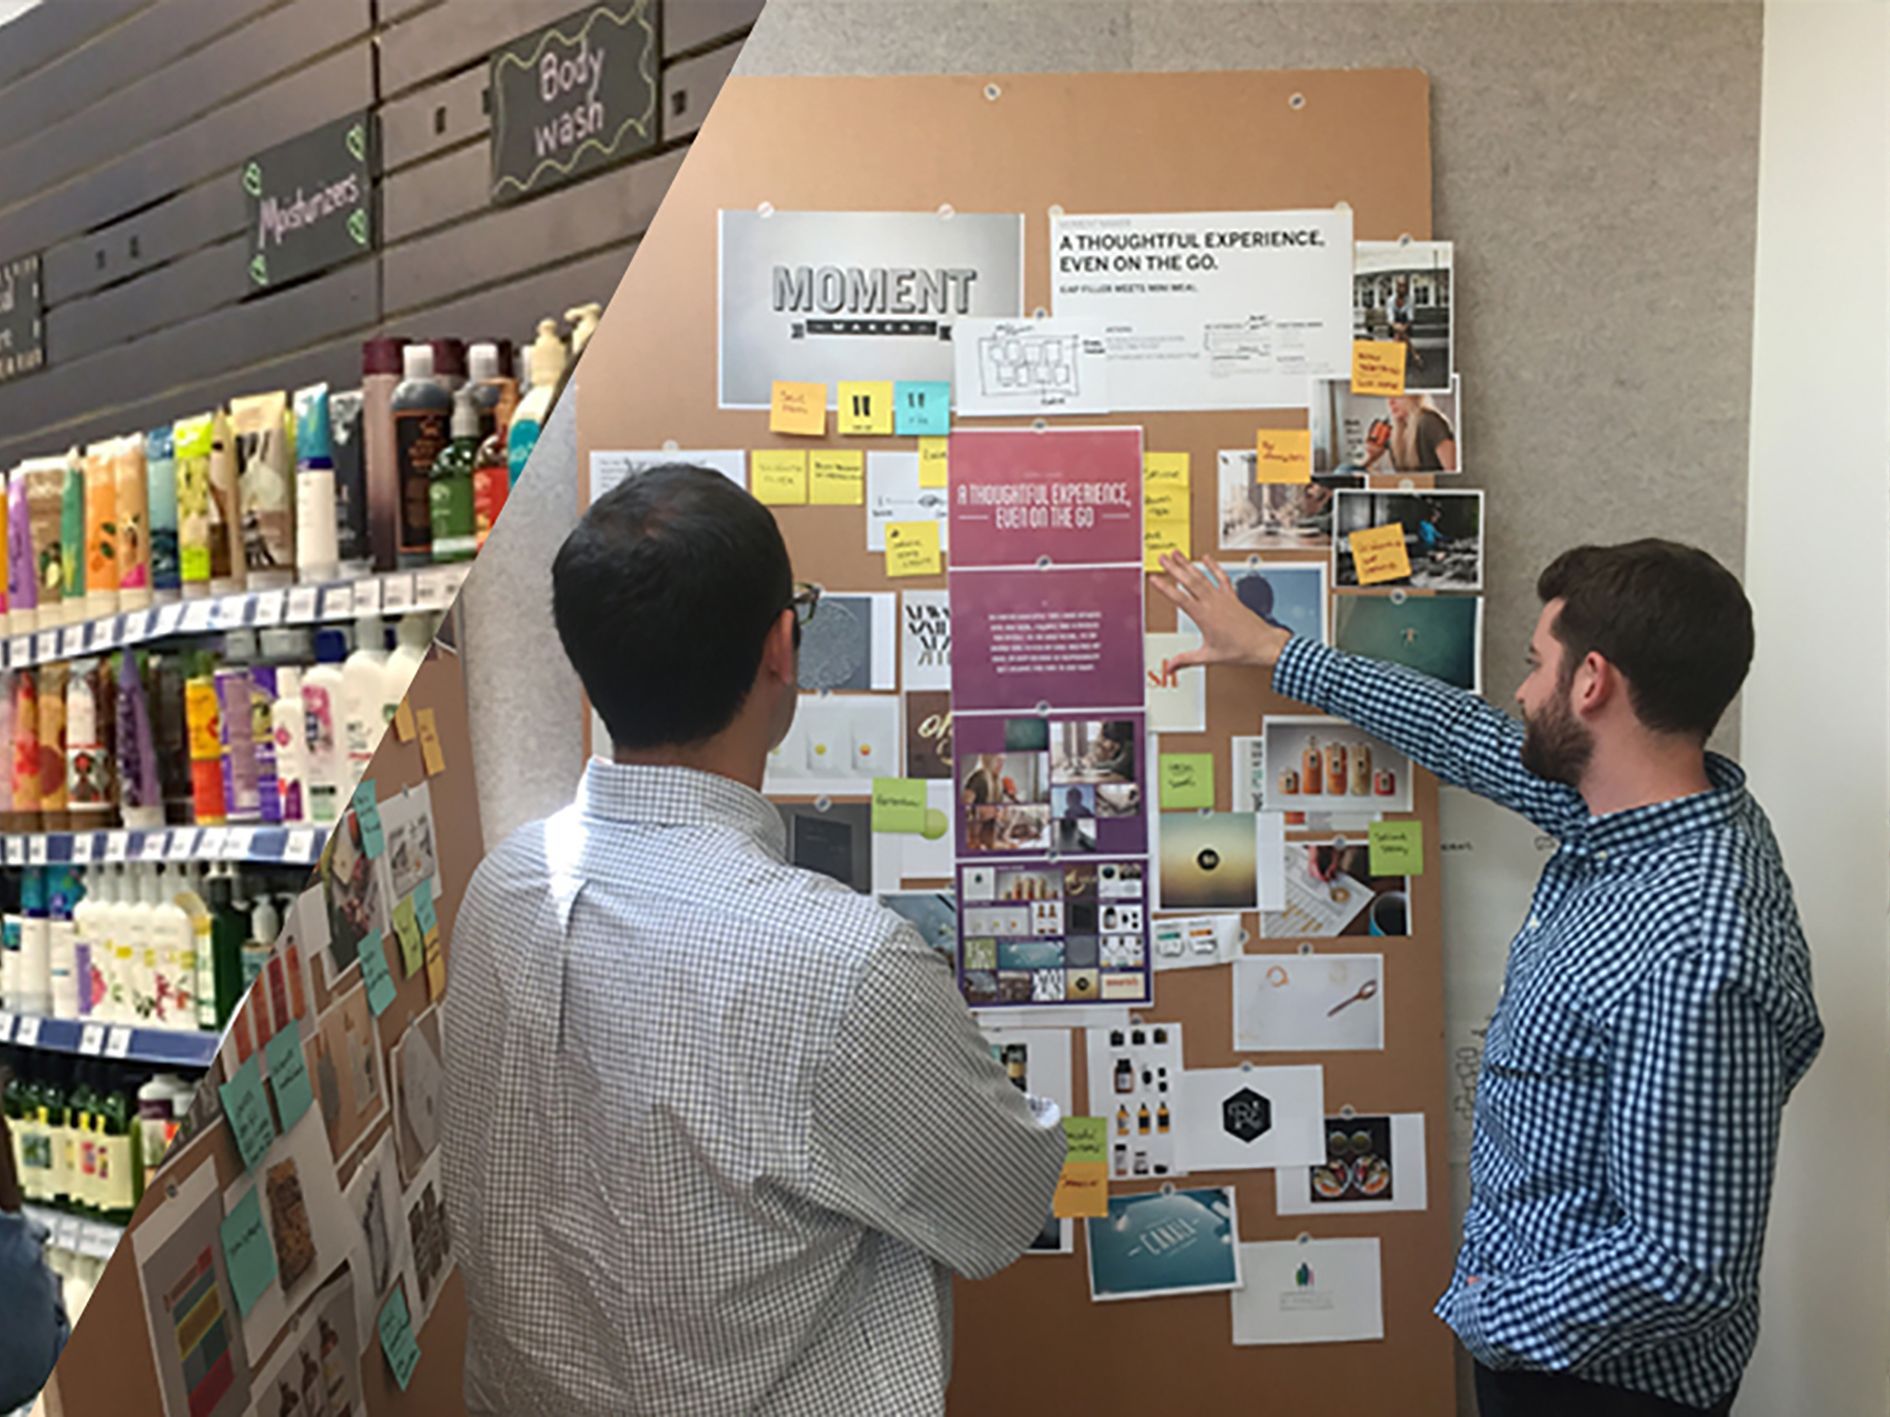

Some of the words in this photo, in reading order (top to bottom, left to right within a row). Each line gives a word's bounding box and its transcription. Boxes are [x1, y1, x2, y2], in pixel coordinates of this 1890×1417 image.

[539, 38, 605, 102] Body
[533, 101, 604, 157] wash
[1059, 235, 1073, 250] A
[1076, 232, 1200, 250] THOUGHTFUL
[1060, 255, 1109, 272] EVEN
[1113, 255, 1141, 272] ON
[1145, 255, 1182, 270] THE
[771, 264, 978, 316] MOMENT
[957, 484, 968, 505] A
[969, 483, 1049, 505] THOUGHTFUL
[995, 506, 1028, 529] EVEN
[1029, 506, 1049, 529] ON
[1050, 506, 1074, 528] THE
[1075, 506, 1095, 528] GO
